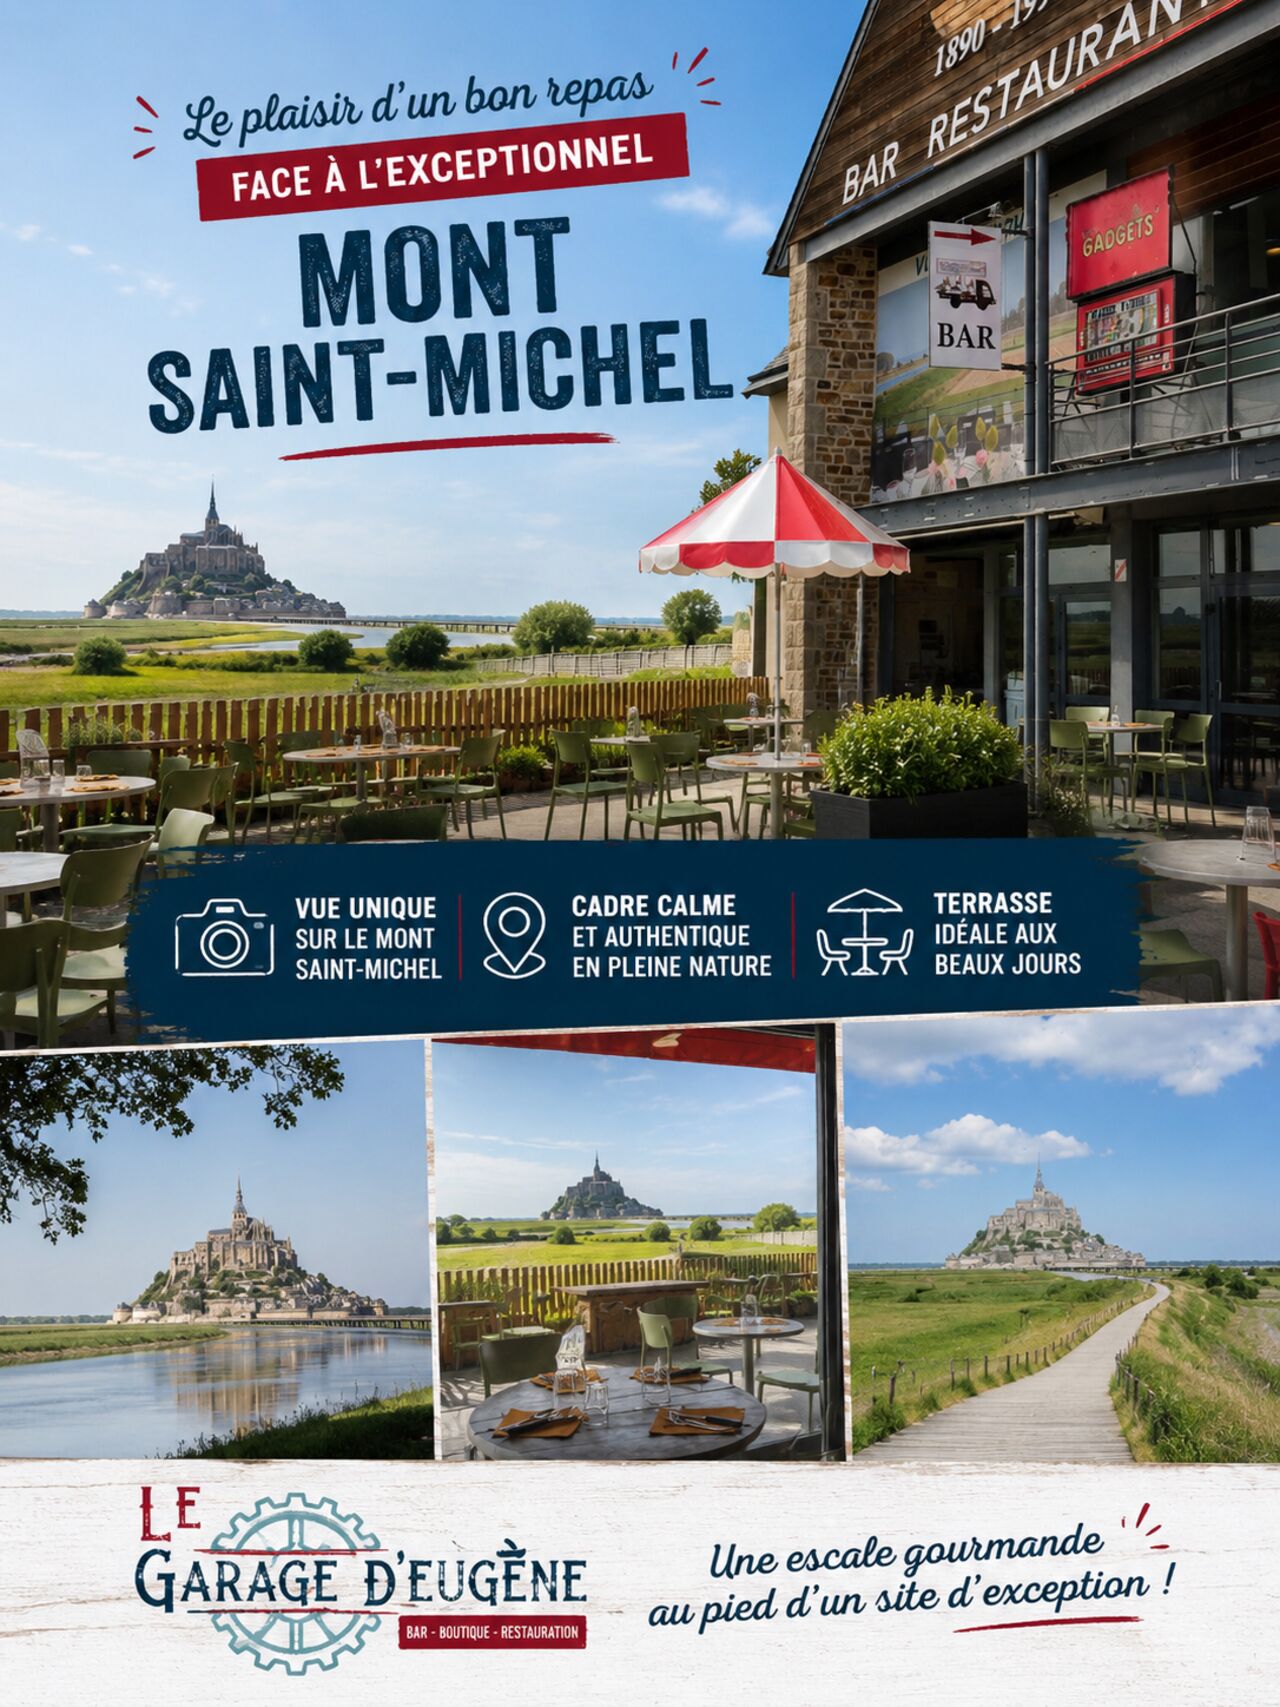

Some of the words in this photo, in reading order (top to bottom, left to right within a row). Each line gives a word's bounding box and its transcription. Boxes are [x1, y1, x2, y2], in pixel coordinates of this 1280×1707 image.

[934, 19, 986, 77] 1890
[842, 141, 899, 205] BAR
[927, 0, 1208, 159] RESTAURAN
[1082, 214, 1154, 258] GADGETS
[937, 322, 996, 350] BAR
